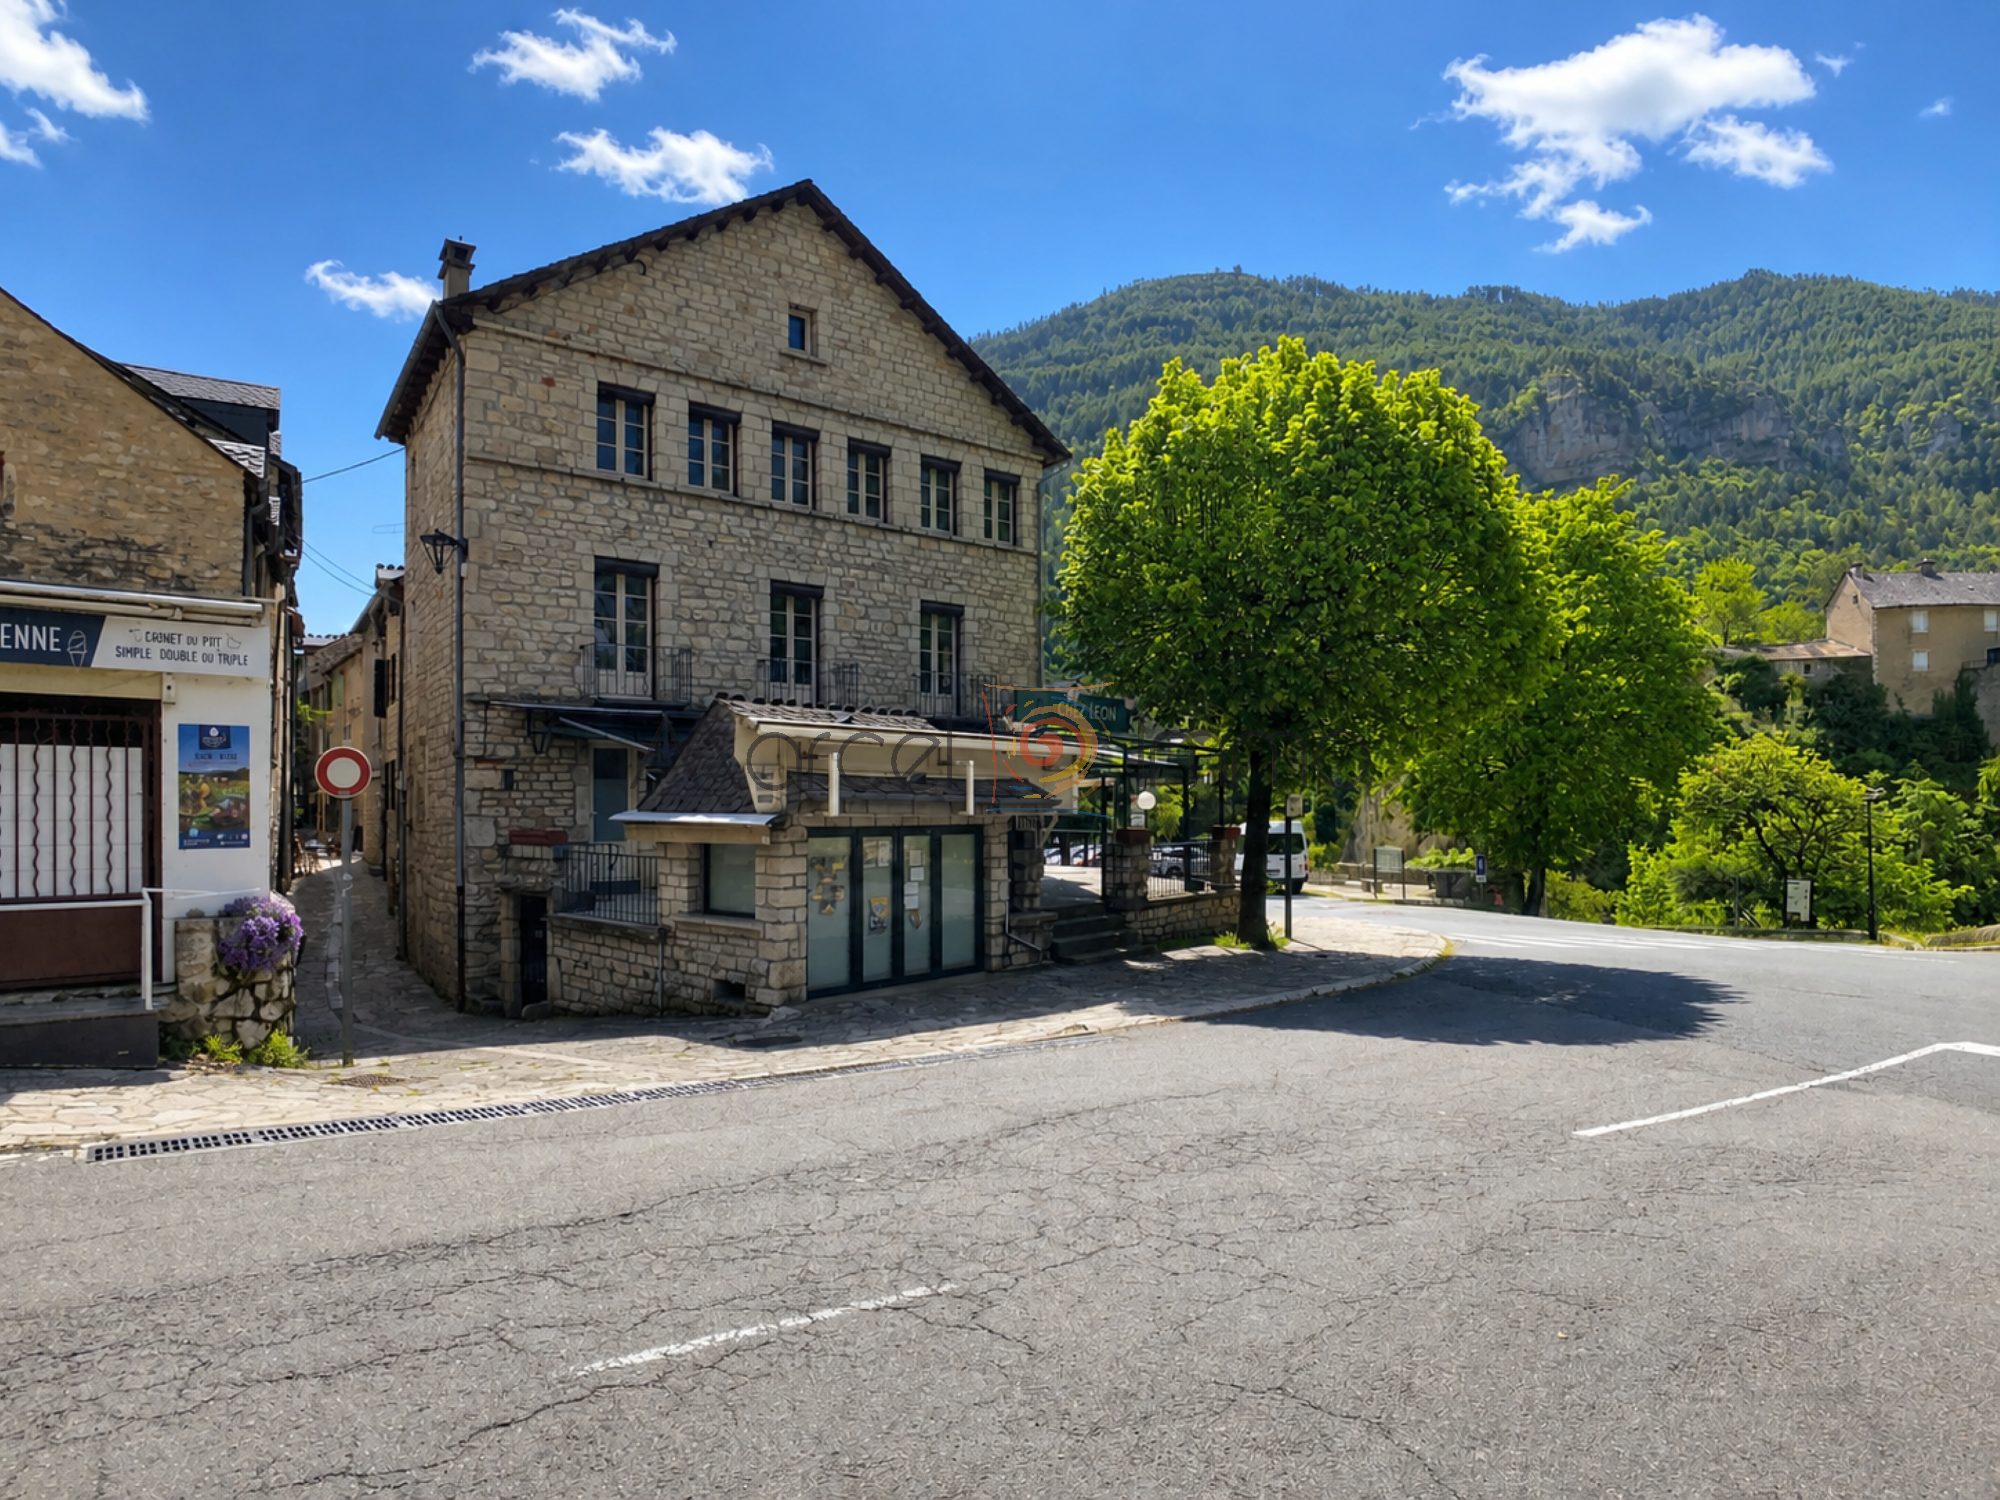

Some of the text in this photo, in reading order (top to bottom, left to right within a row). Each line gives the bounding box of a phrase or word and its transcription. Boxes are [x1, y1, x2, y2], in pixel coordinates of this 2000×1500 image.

[0, 623, 61, 651] ENNE
[115, 645, 248, 666] SIMPLE DOUBLE OU TRIPLE
